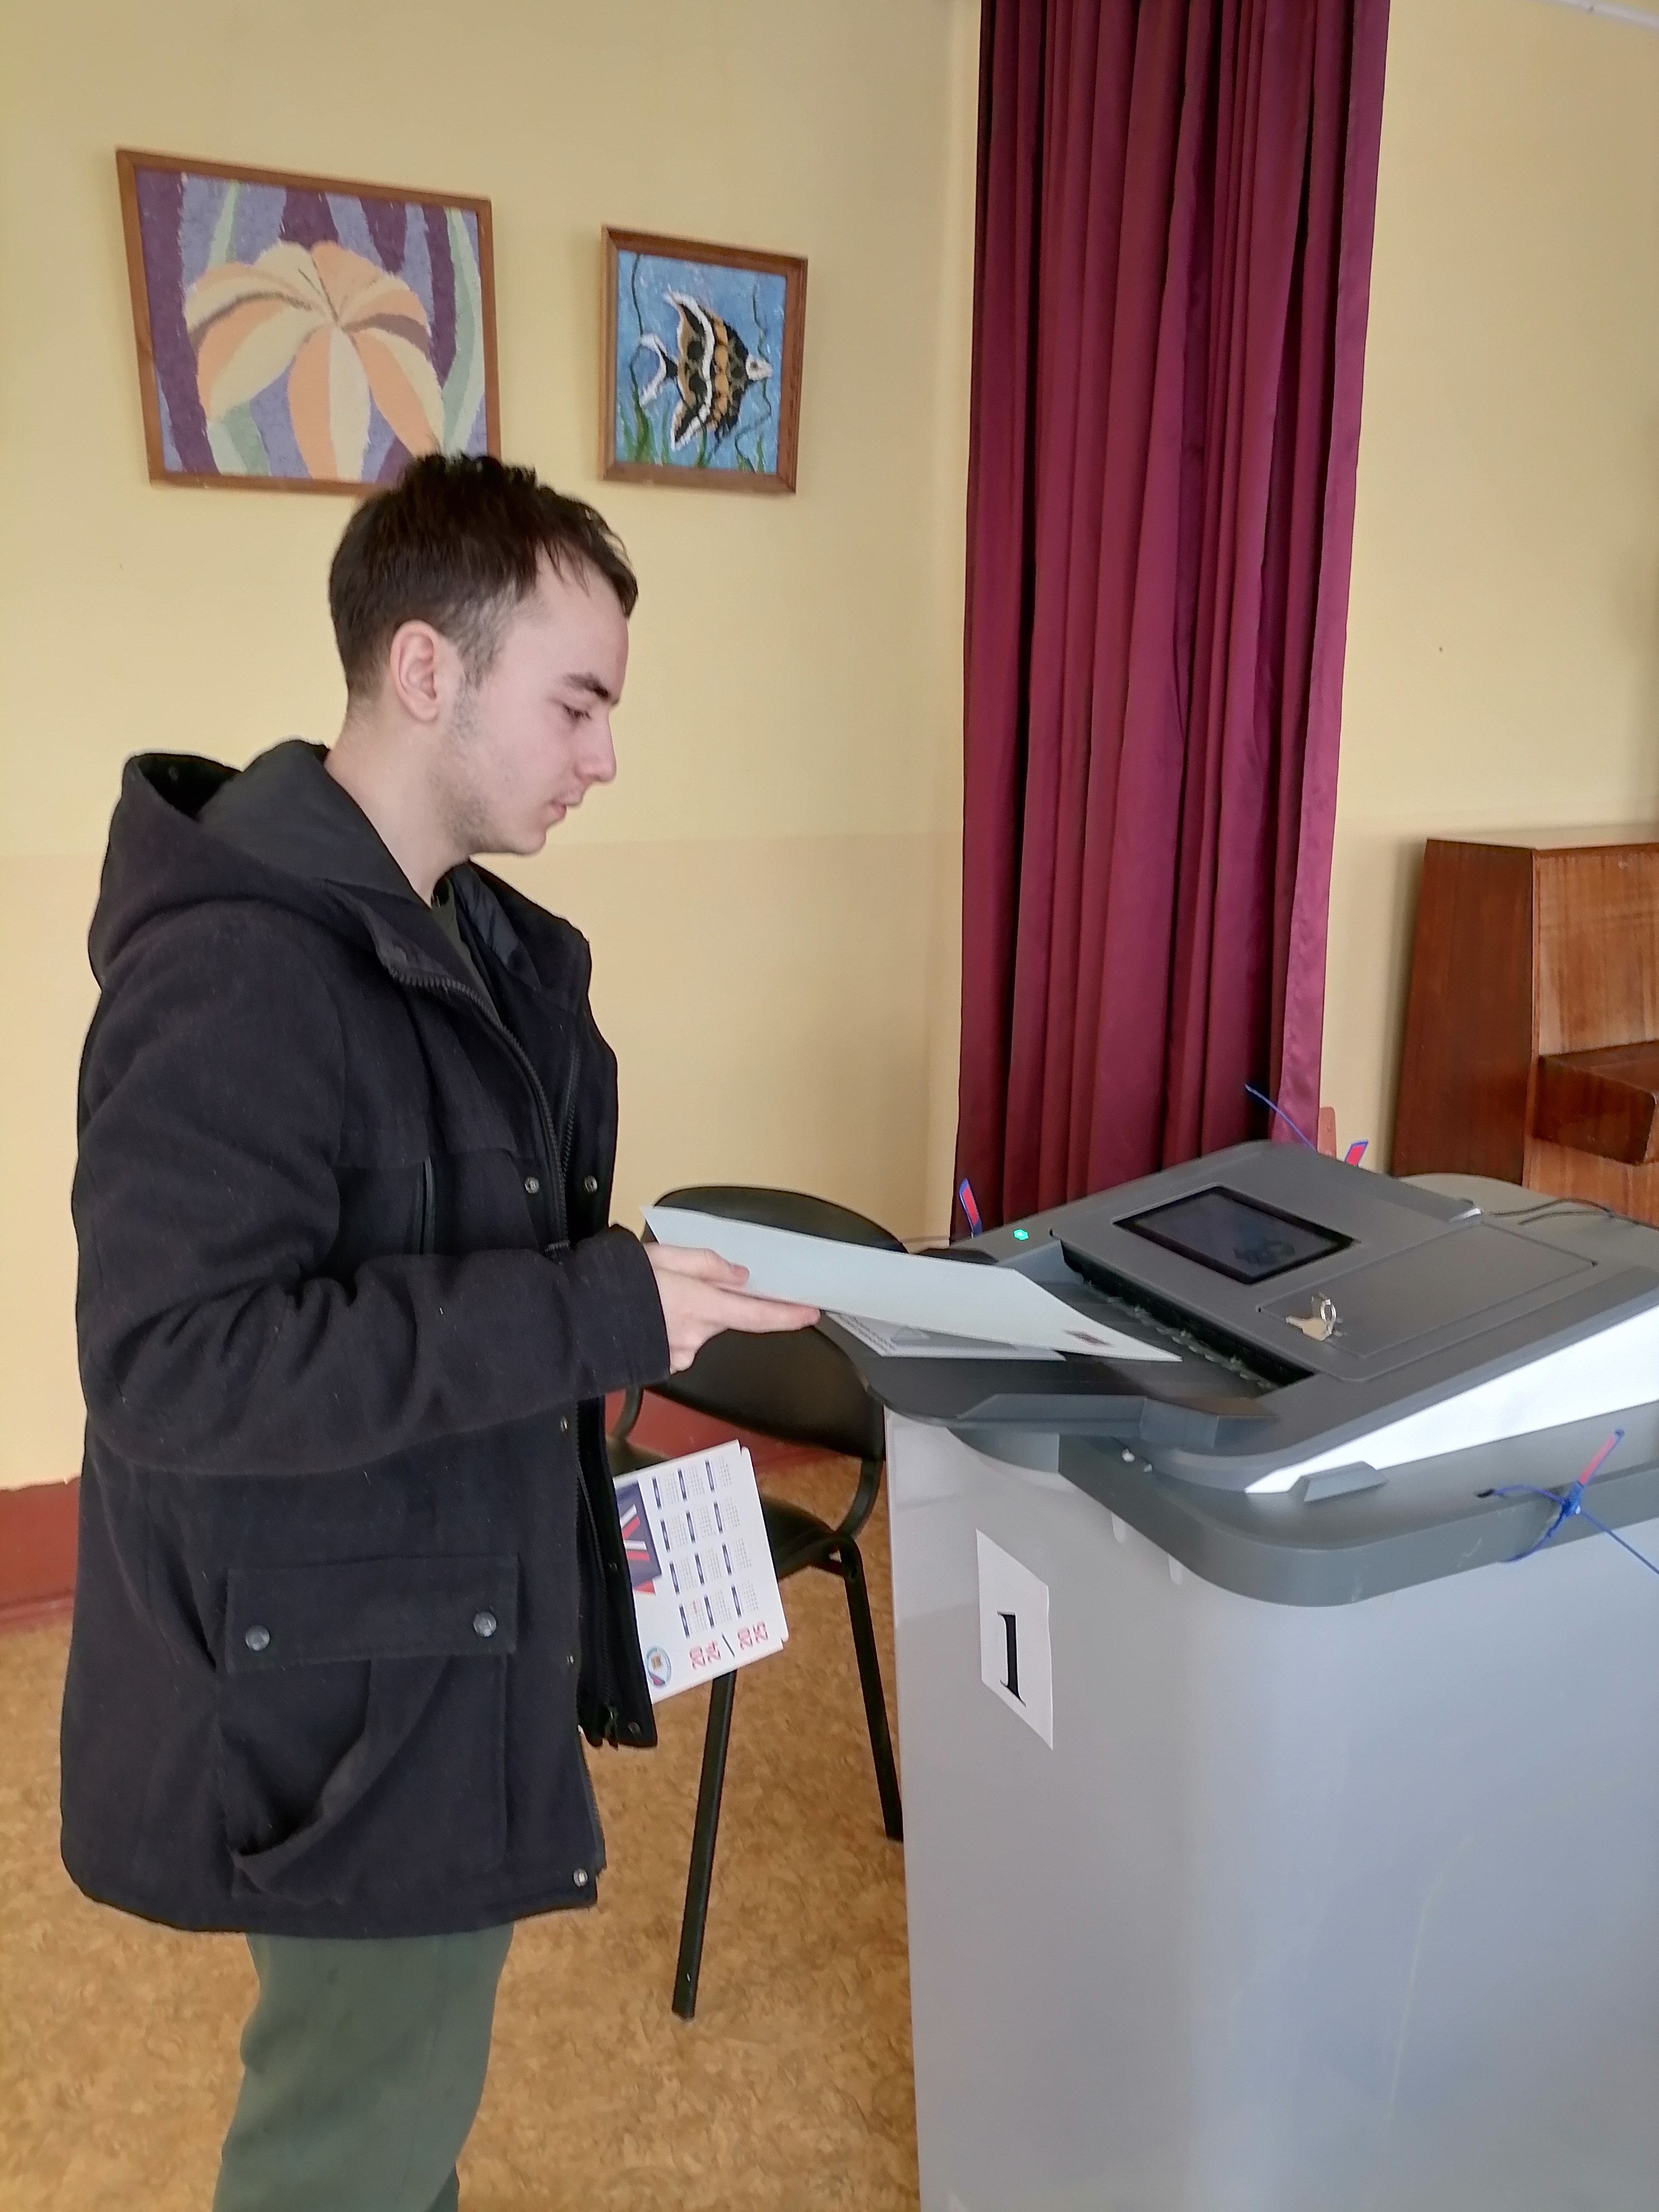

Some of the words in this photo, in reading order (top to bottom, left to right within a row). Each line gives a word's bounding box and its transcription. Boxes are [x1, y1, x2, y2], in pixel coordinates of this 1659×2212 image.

[738, 1627, 753, 1650] 20
[689, 1646, 706, 1670] 20
[997, 1610, 1027, 1708] 1
